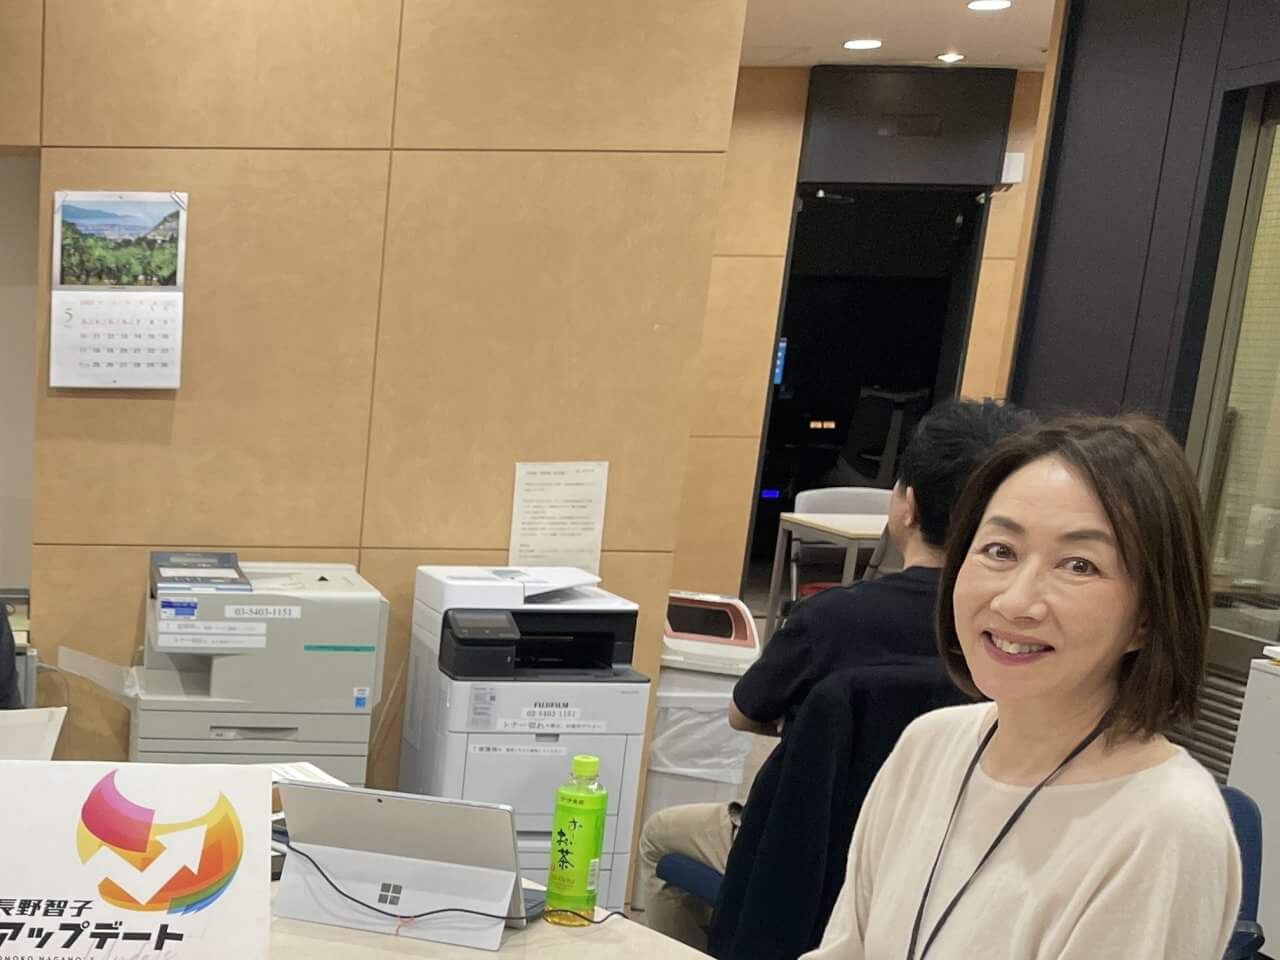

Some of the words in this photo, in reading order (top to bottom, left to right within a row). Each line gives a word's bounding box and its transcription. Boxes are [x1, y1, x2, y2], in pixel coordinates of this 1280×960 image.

[64, 308, 73, 323] 5
[235, 608, 292, 617] 03-5403-1151
[556, 828, 574, 870] お茶
